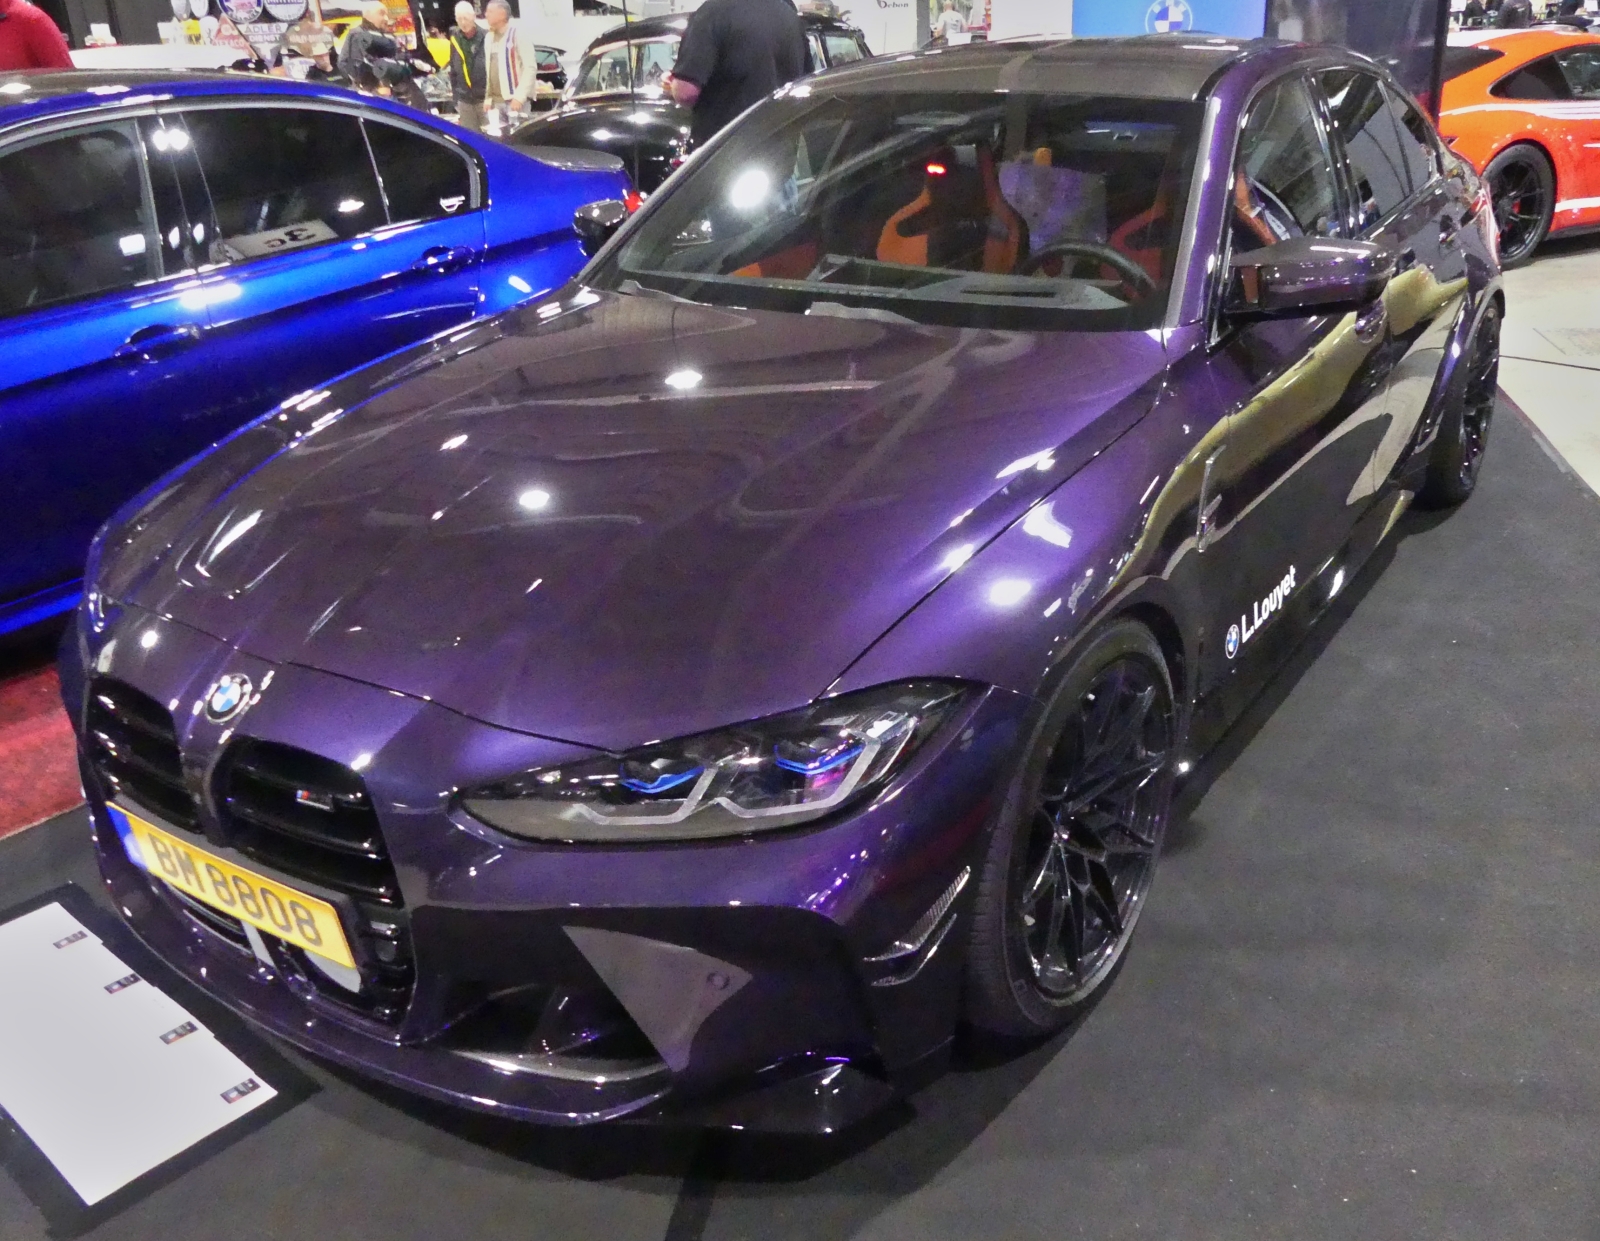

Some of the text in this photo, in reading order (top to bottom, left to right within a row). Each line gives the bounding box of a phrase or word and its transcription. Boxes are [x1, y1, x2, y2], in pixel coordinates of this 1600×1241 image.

[244, 24, 283, 33] ADLER
[1241, 564, 1296, 643] L.Louyet
[147, 832, 323, 947] BM 8808
